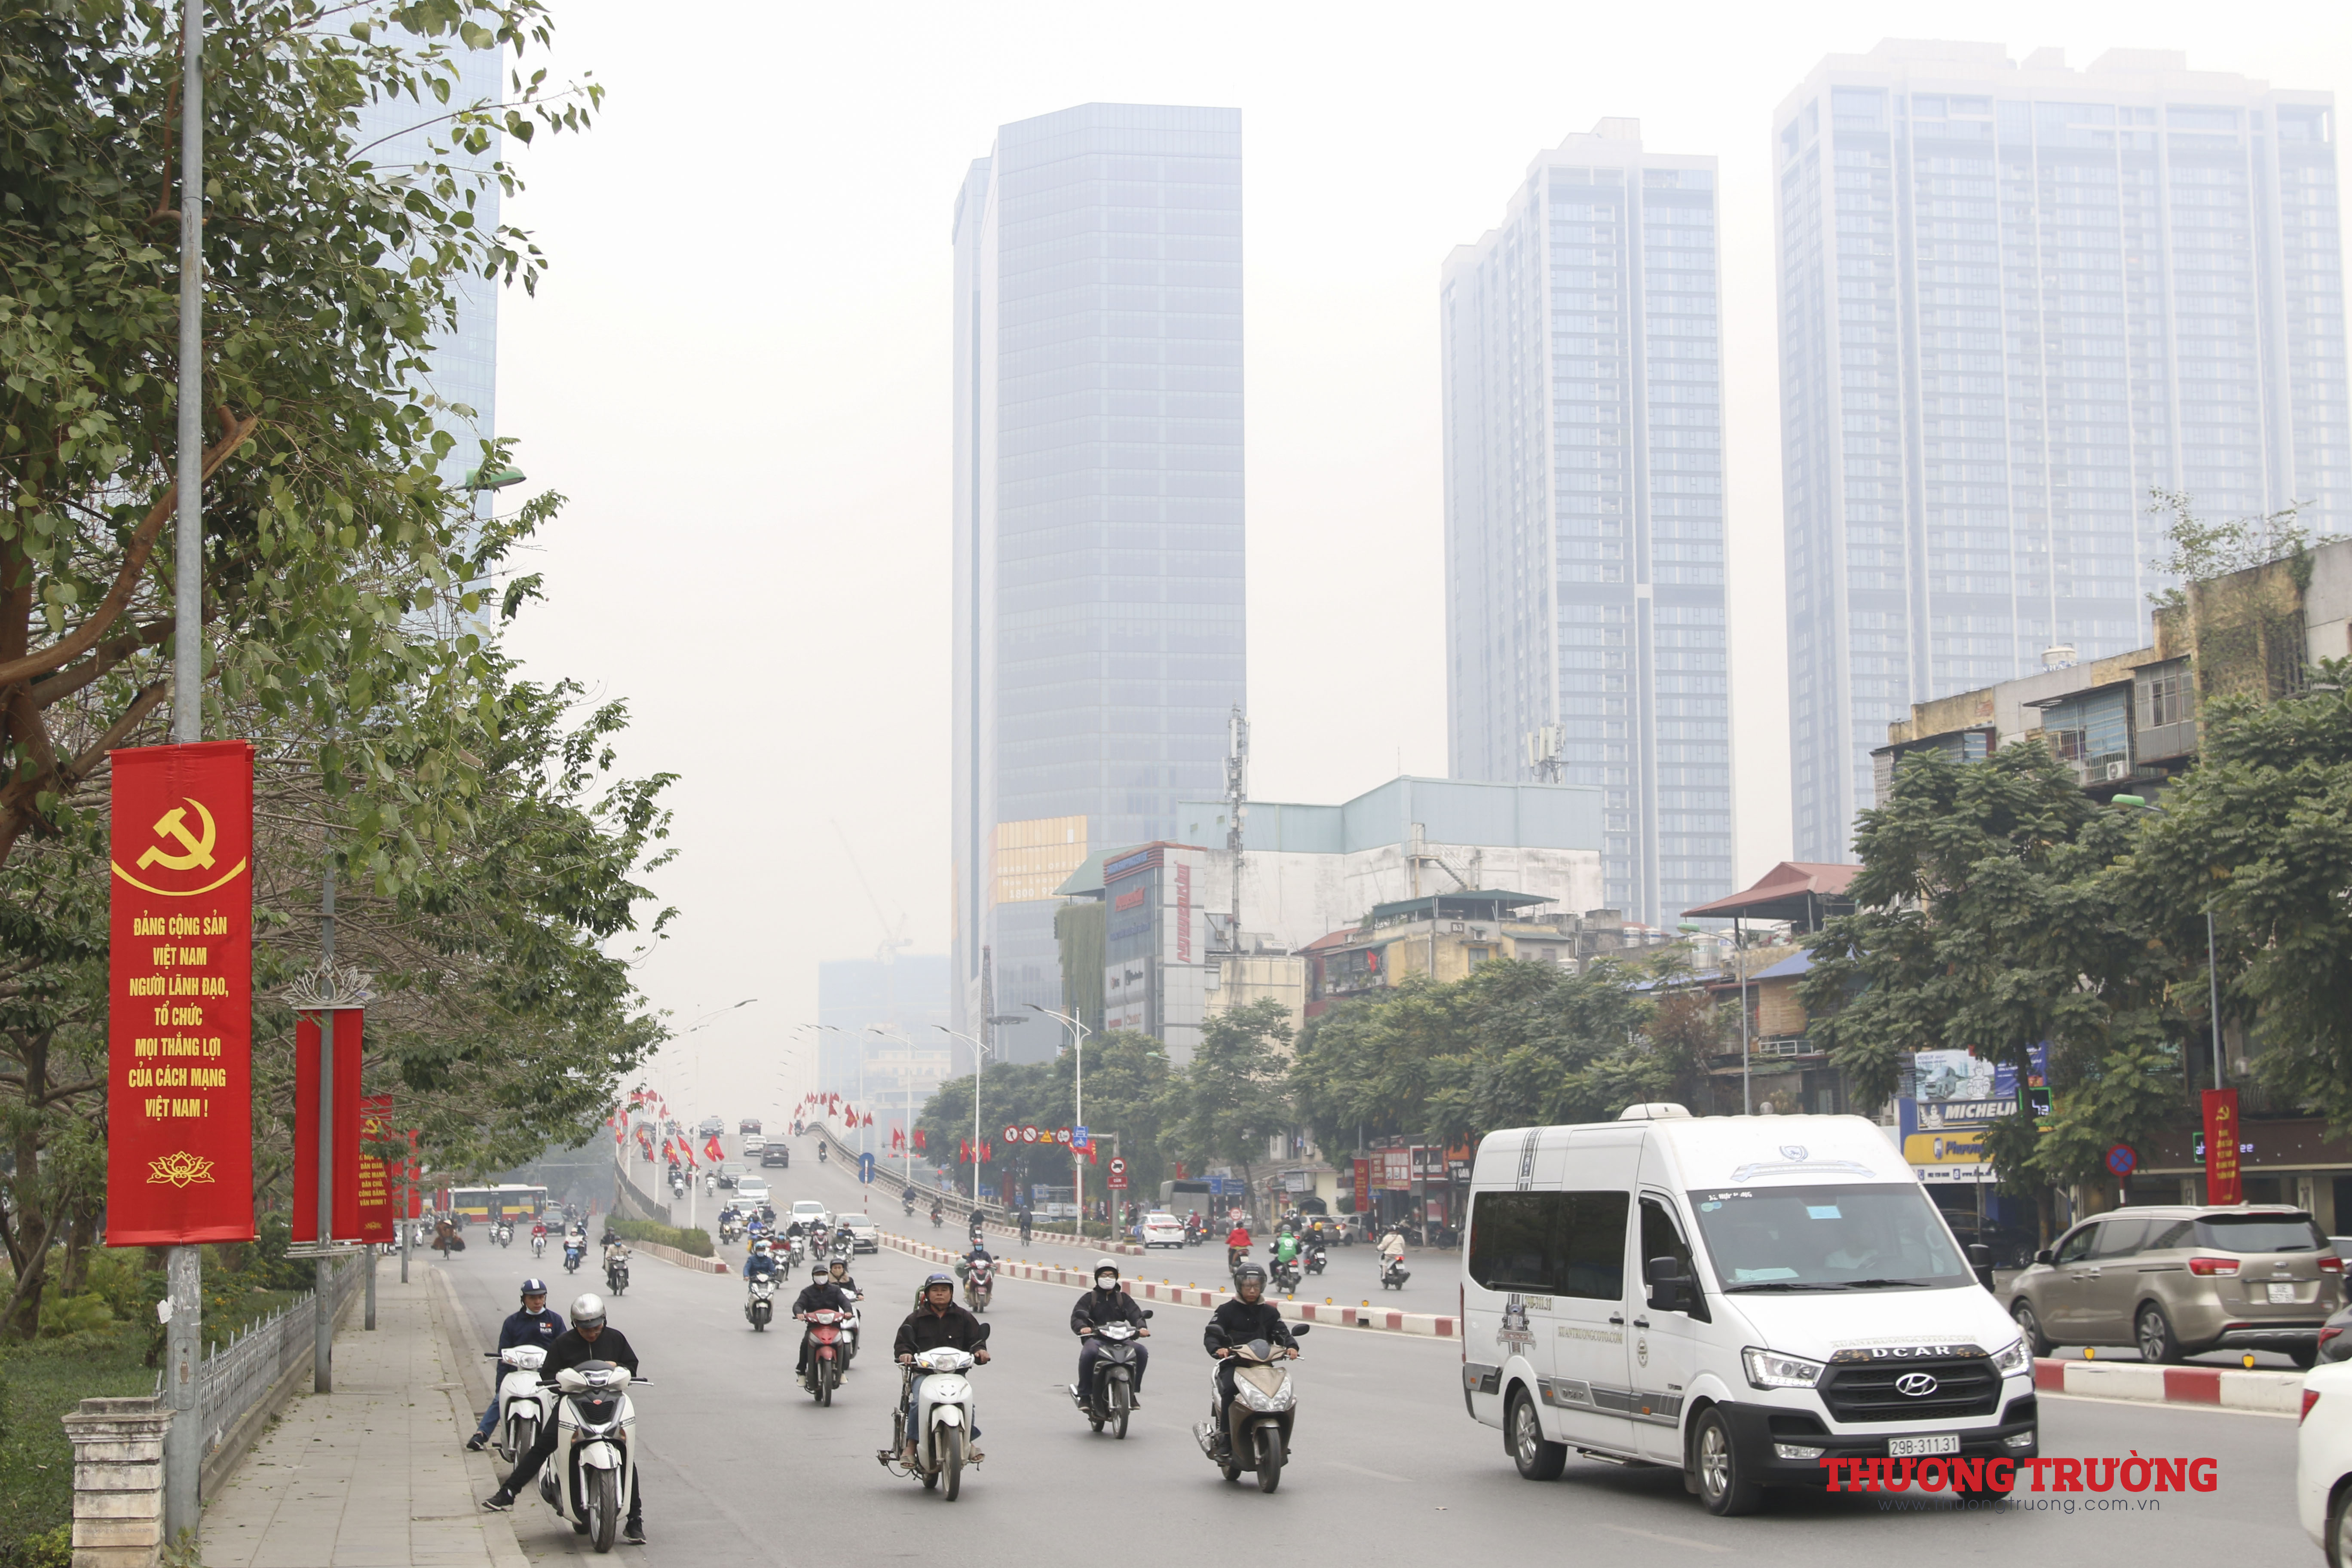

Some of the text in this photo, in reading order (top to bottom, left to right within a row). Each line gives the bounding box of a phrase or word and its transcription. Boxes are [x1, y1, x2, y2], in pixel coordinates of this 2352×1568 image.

[1010, 888, 1034, 898] 1800
[133, 909, 227, 939] ĐẢNG CỘNG SẢN
[153, 943, 207, 969] VIỆT NAM
[129, 972, 229, 1000] NGƯỜI LÃNH ĐẠO,
[154, 1000, 203, 1026] TỔ CHỨC
[135, 1032, 221, 1061] MỌI THẮNG LỢI
[129, 1061, 226, 1091] CỦA CÁCH MẠNG
[145, 1095, 170, 1121] VIỆT
[172, 1099, 200, 1117] NAM
[1871, 1346, 1951, 1358] DCAR
[1891, 1437, 1956, 1455] 29B-311.31
